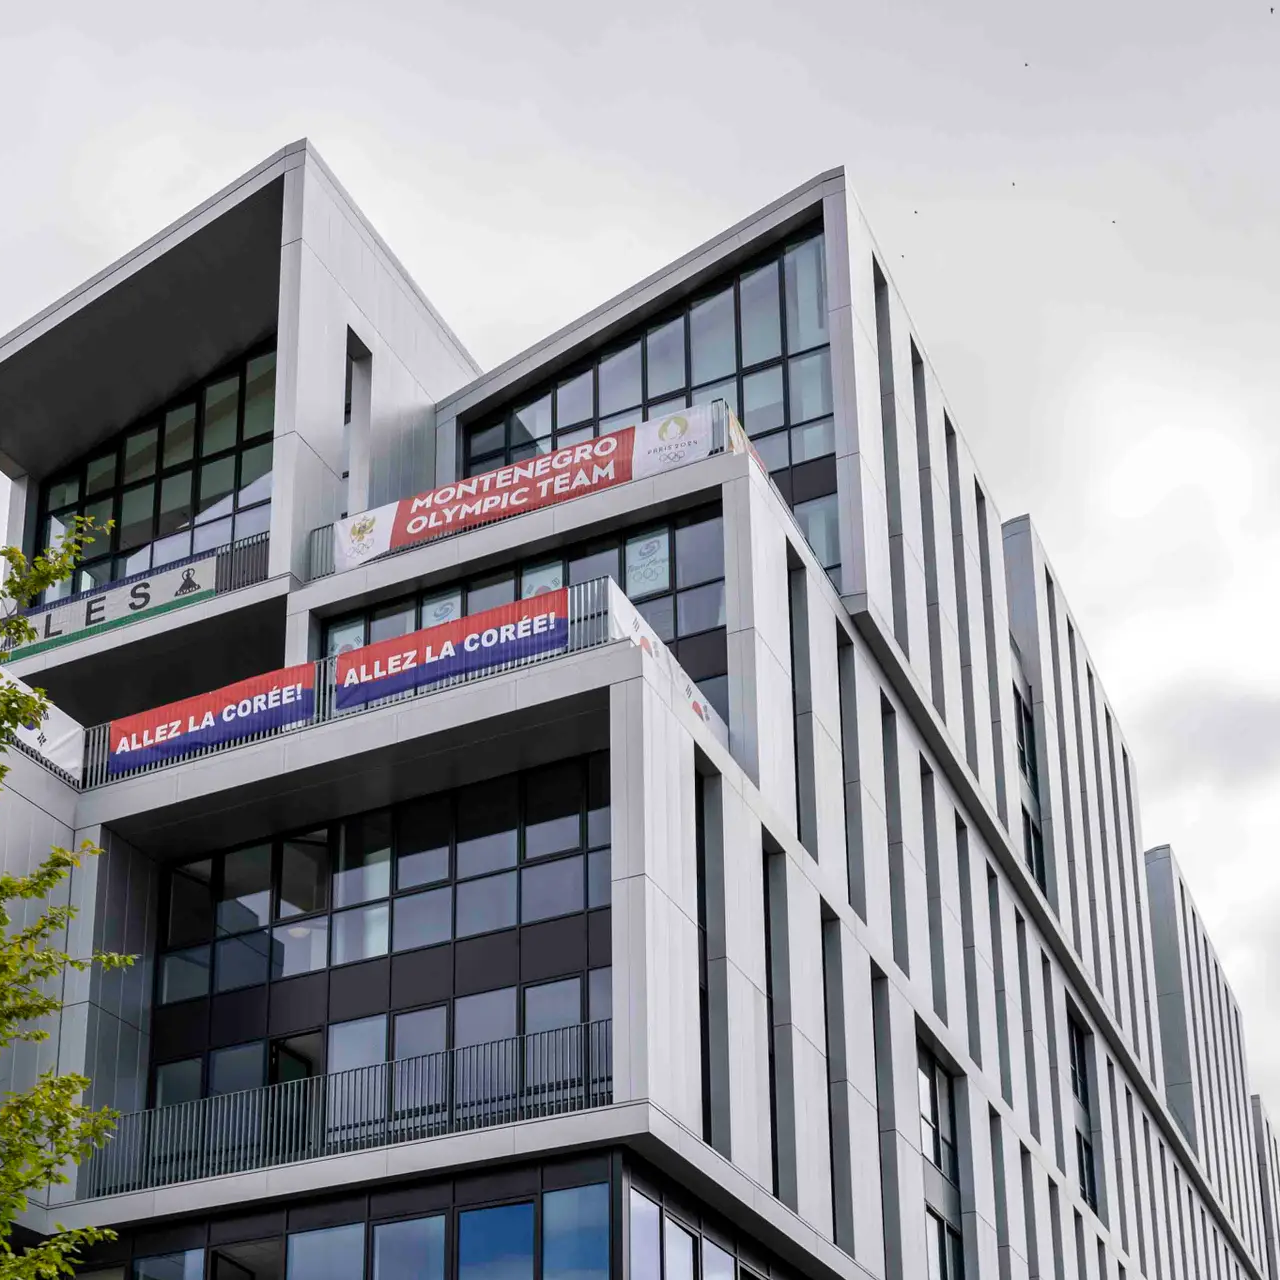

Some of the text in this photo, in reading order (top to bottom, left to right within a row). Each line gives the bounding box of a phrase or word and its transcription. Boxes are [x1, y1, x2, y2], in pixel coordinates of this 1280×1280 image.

[410, 436, 618, 514] MONTENEGRO
[647, 440, 699, 455] PARIS 2024
[406, 460, 616, 534] OLYMPIC TEAM
[344, 612, 556, 688] ALLEZ LA CORÉE!
[116, 682, 303, 755] ALLEZ LA CORÉE!
